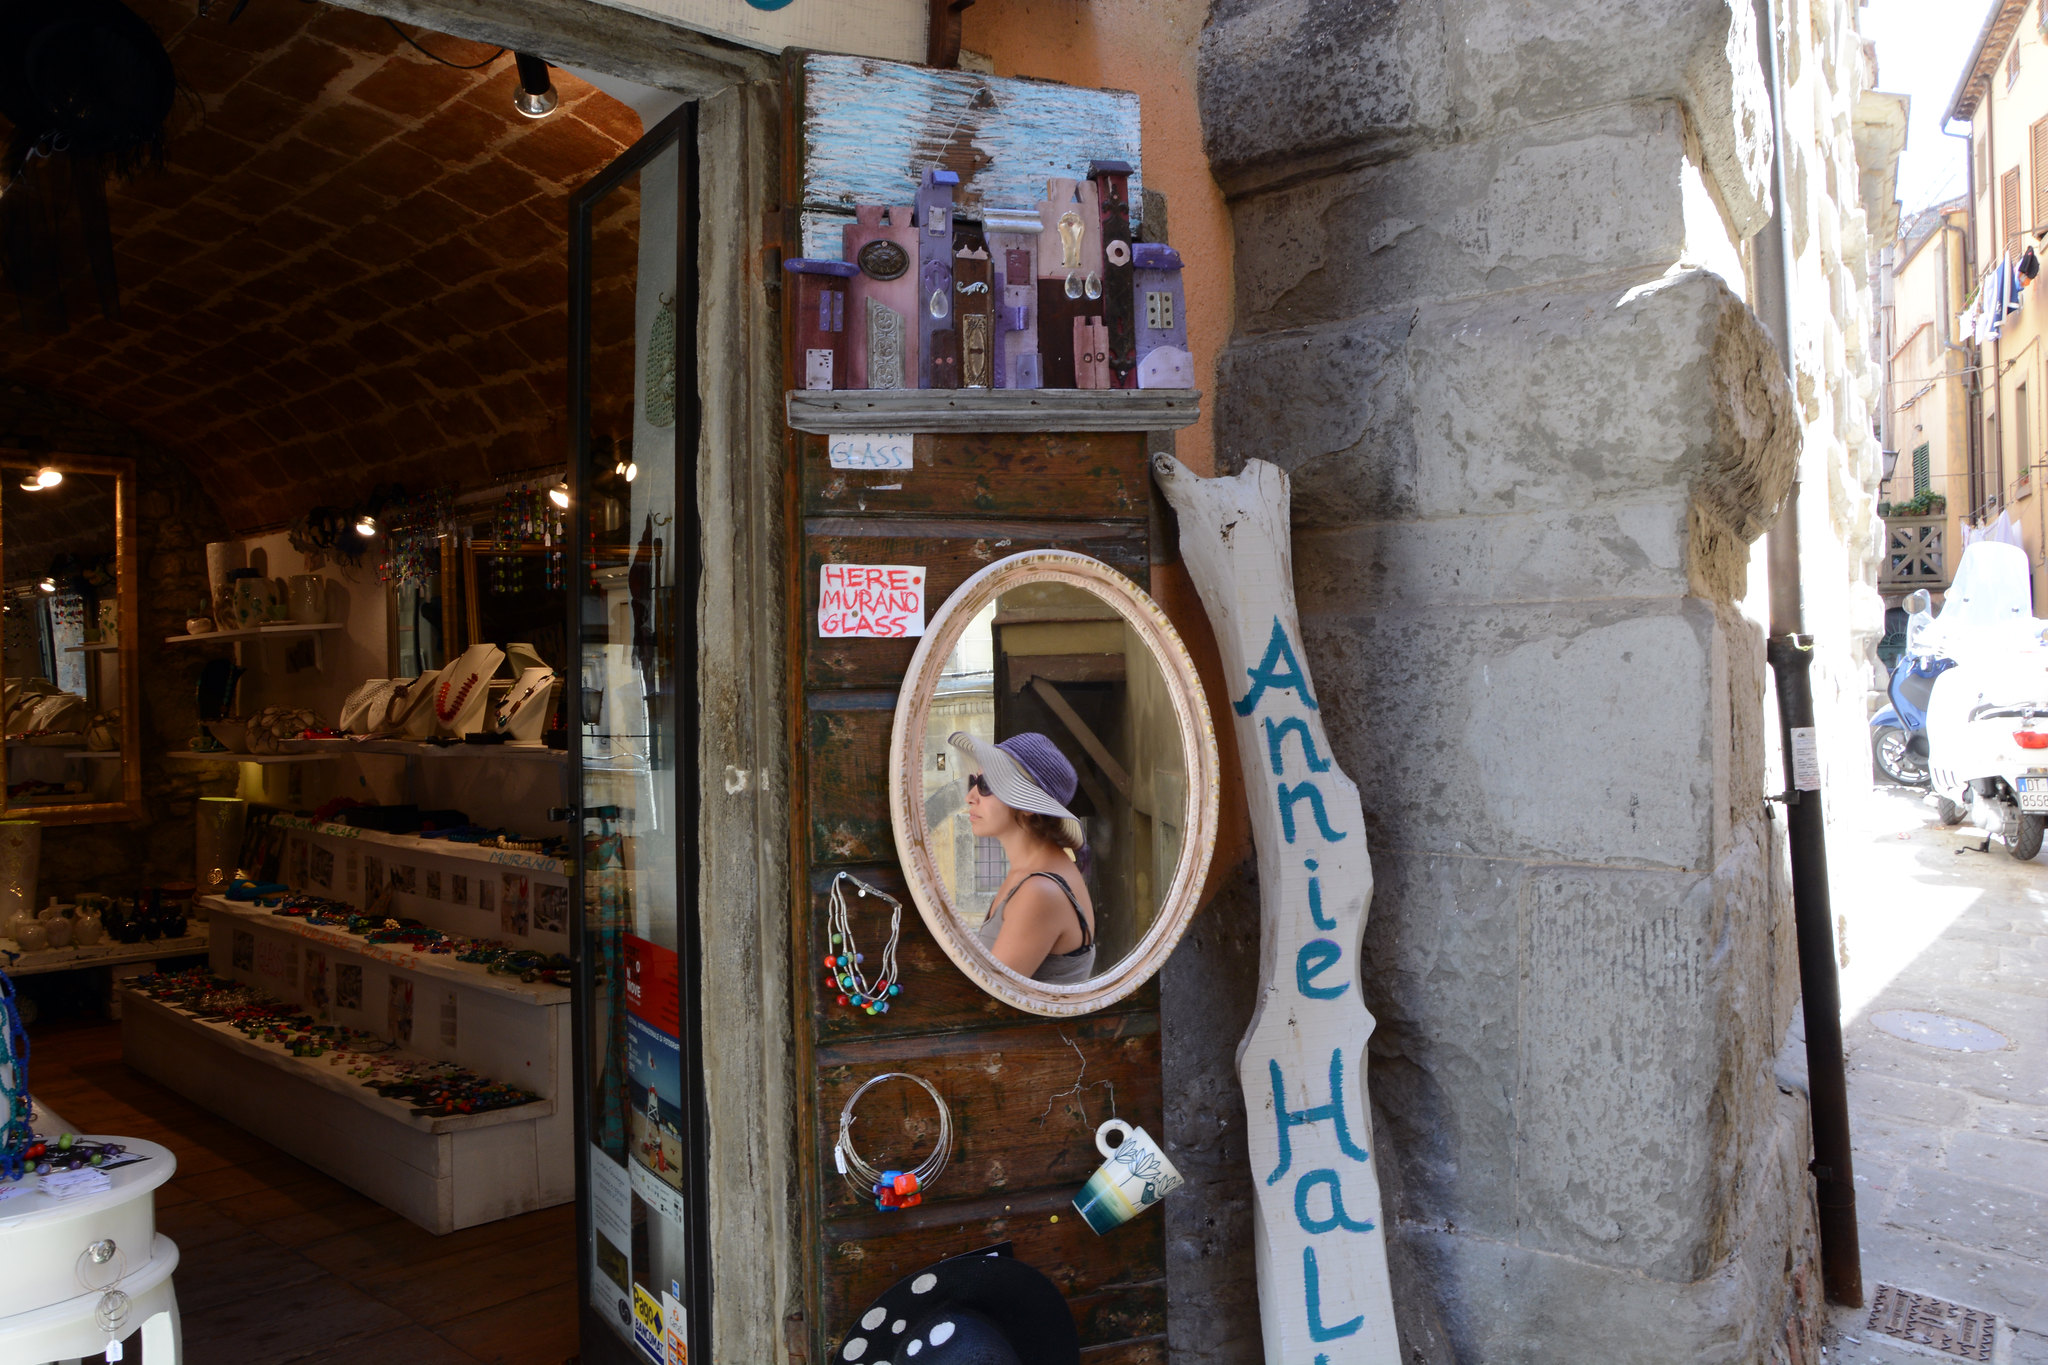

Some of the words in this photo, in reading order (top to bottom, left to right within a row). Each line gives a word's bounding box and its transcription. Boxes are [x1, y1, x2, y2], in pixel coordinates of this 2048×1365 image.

[831, 441, 903, 468] GLASS
[825, 566, 909, 590] HERE
[823, 588, 919, 615] MURANO
[821, 612, 908, 637] GLASS
[2027, 779, 2039, 791] DT
[1233, 614, 1348, 1000] Annie
[326, 825, 362, 838] GLASS
[489, 850, 557, 872] MURANO
[289, 922, 350, 949] MURANO
[359, 943, 420, 972] GLASS
[626, 979, 641, 999] MOVE
[1266, 1047, 1376, 1365] HaL
[633, 1286, 653, 1326] Pago
[635, 1317, 664, 1355] BANCOMAT
